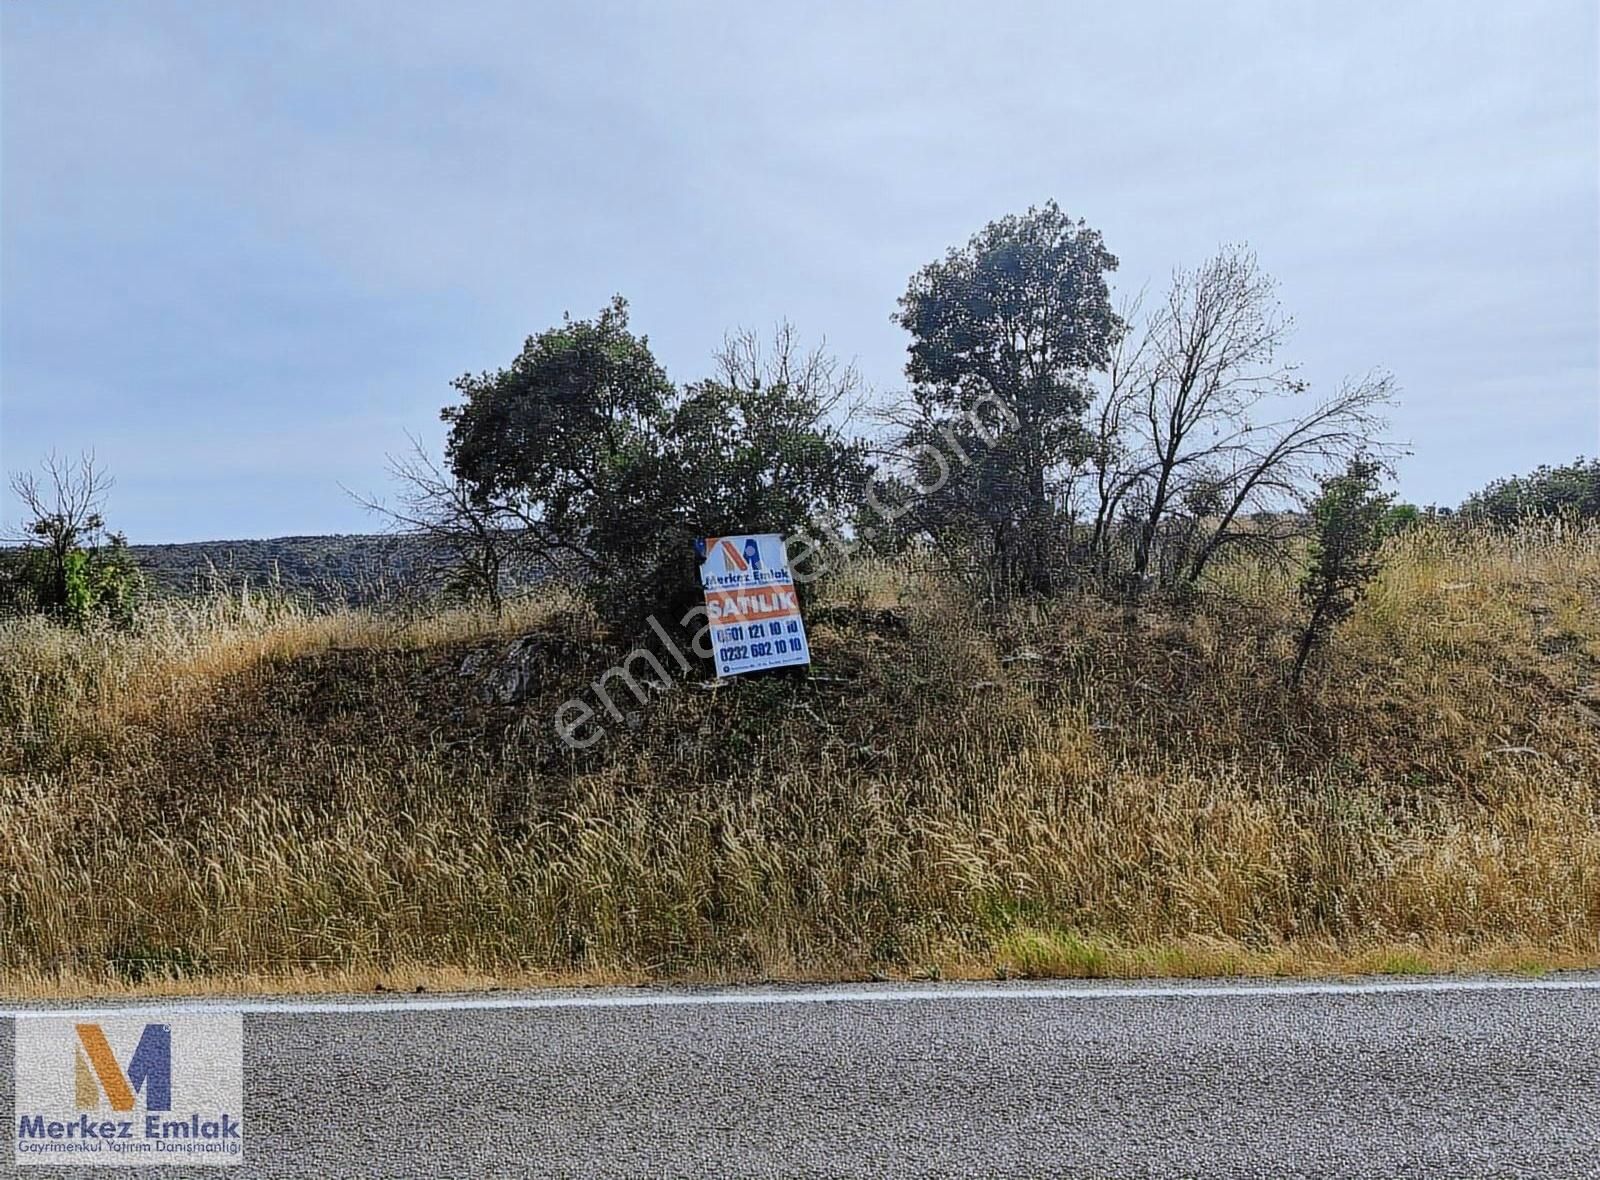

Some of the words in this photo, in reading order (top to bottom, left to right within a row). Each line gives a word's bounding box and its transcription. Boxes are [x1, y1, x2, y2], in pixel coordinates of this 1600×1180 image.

[708, 591, 796, 619] SATILIK
[748, 624, 765, 639] 121
[769, 621, 782, 636] 10
[785, 620, 799, 634] 10
[720, 645, 749, 662] 0232
[775, 639, 787, 655] 10
[789, 637, 802, 652] 10
